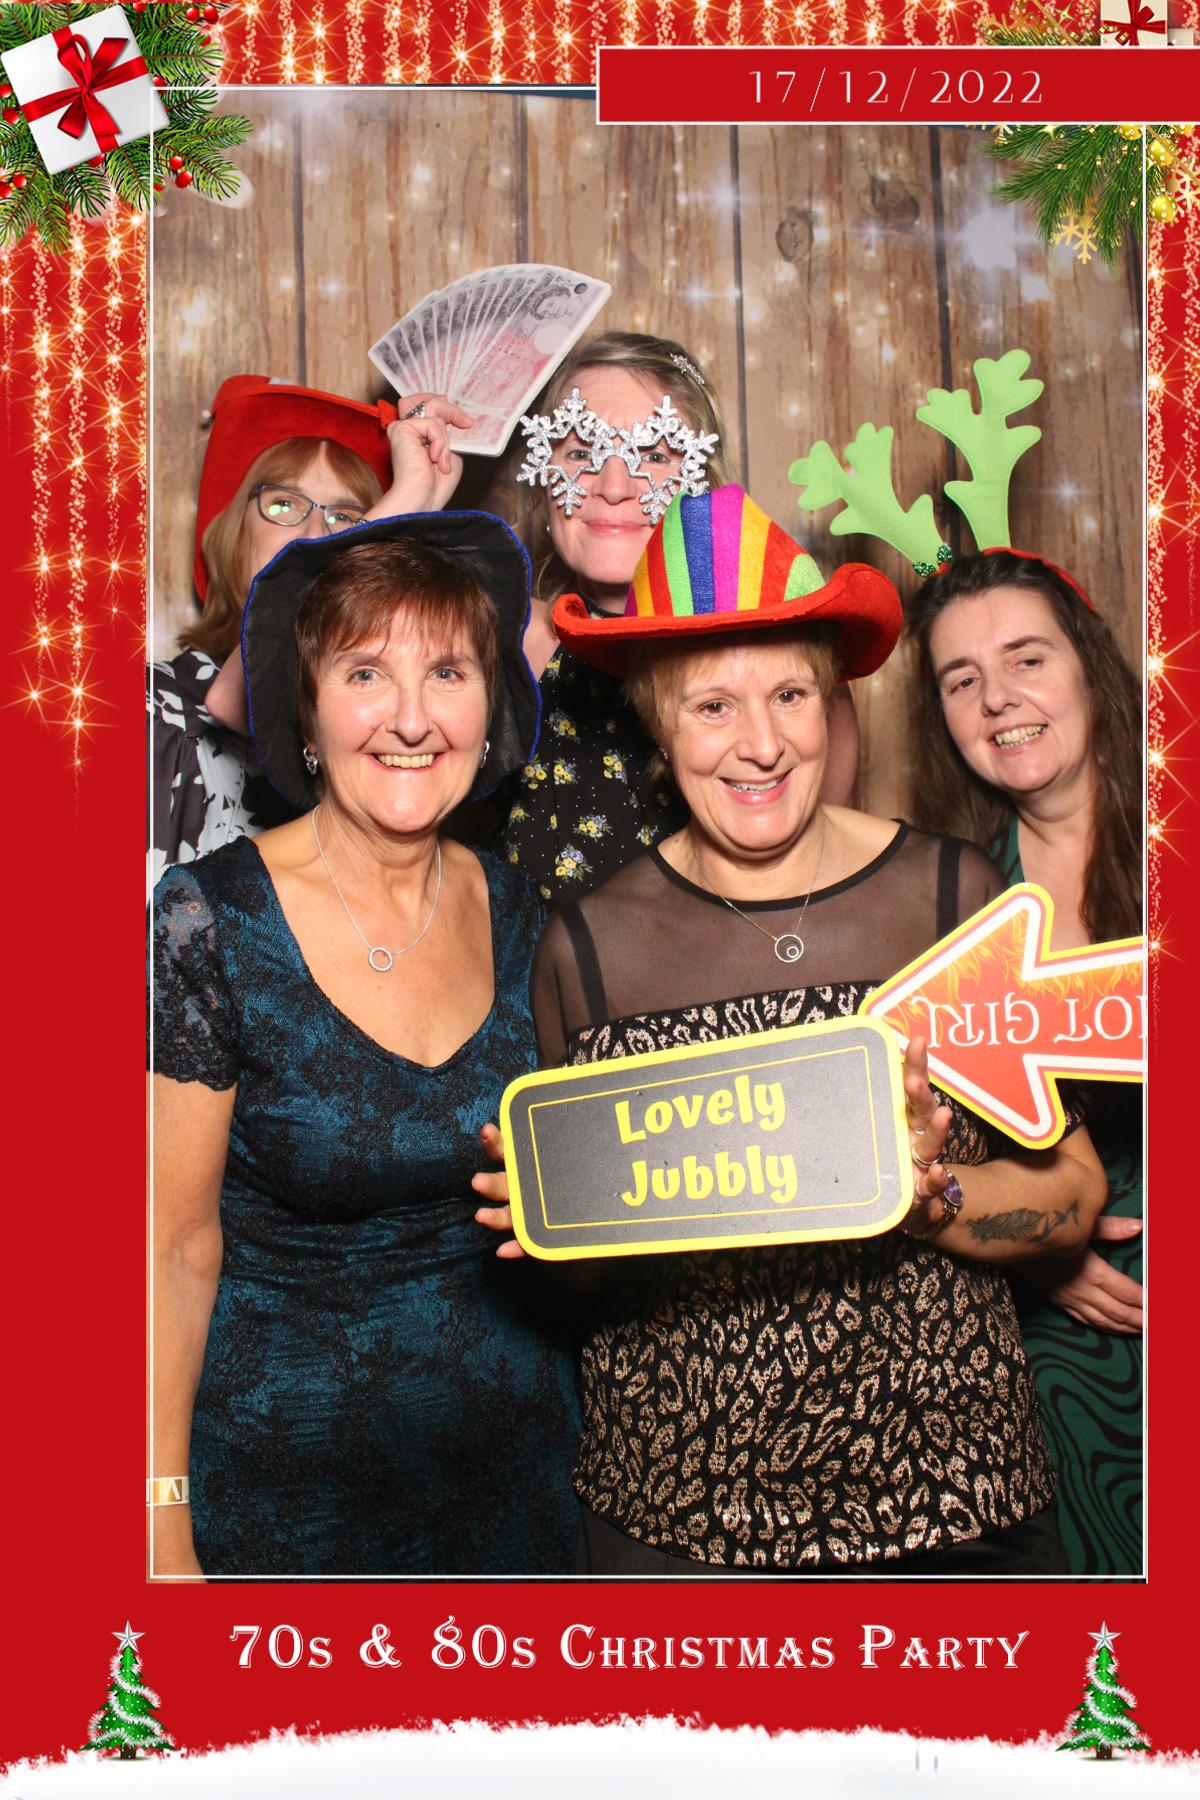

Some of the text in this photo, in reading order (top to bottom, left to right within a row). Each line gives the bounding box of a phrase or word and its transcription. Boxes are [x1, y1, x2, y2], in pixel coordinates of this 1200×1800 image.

[911, 991, 1040, 1049] GIRL
[614, 1074, 786, 1144] Lovely
[621, 1145, 798, 1207] Jubbly
